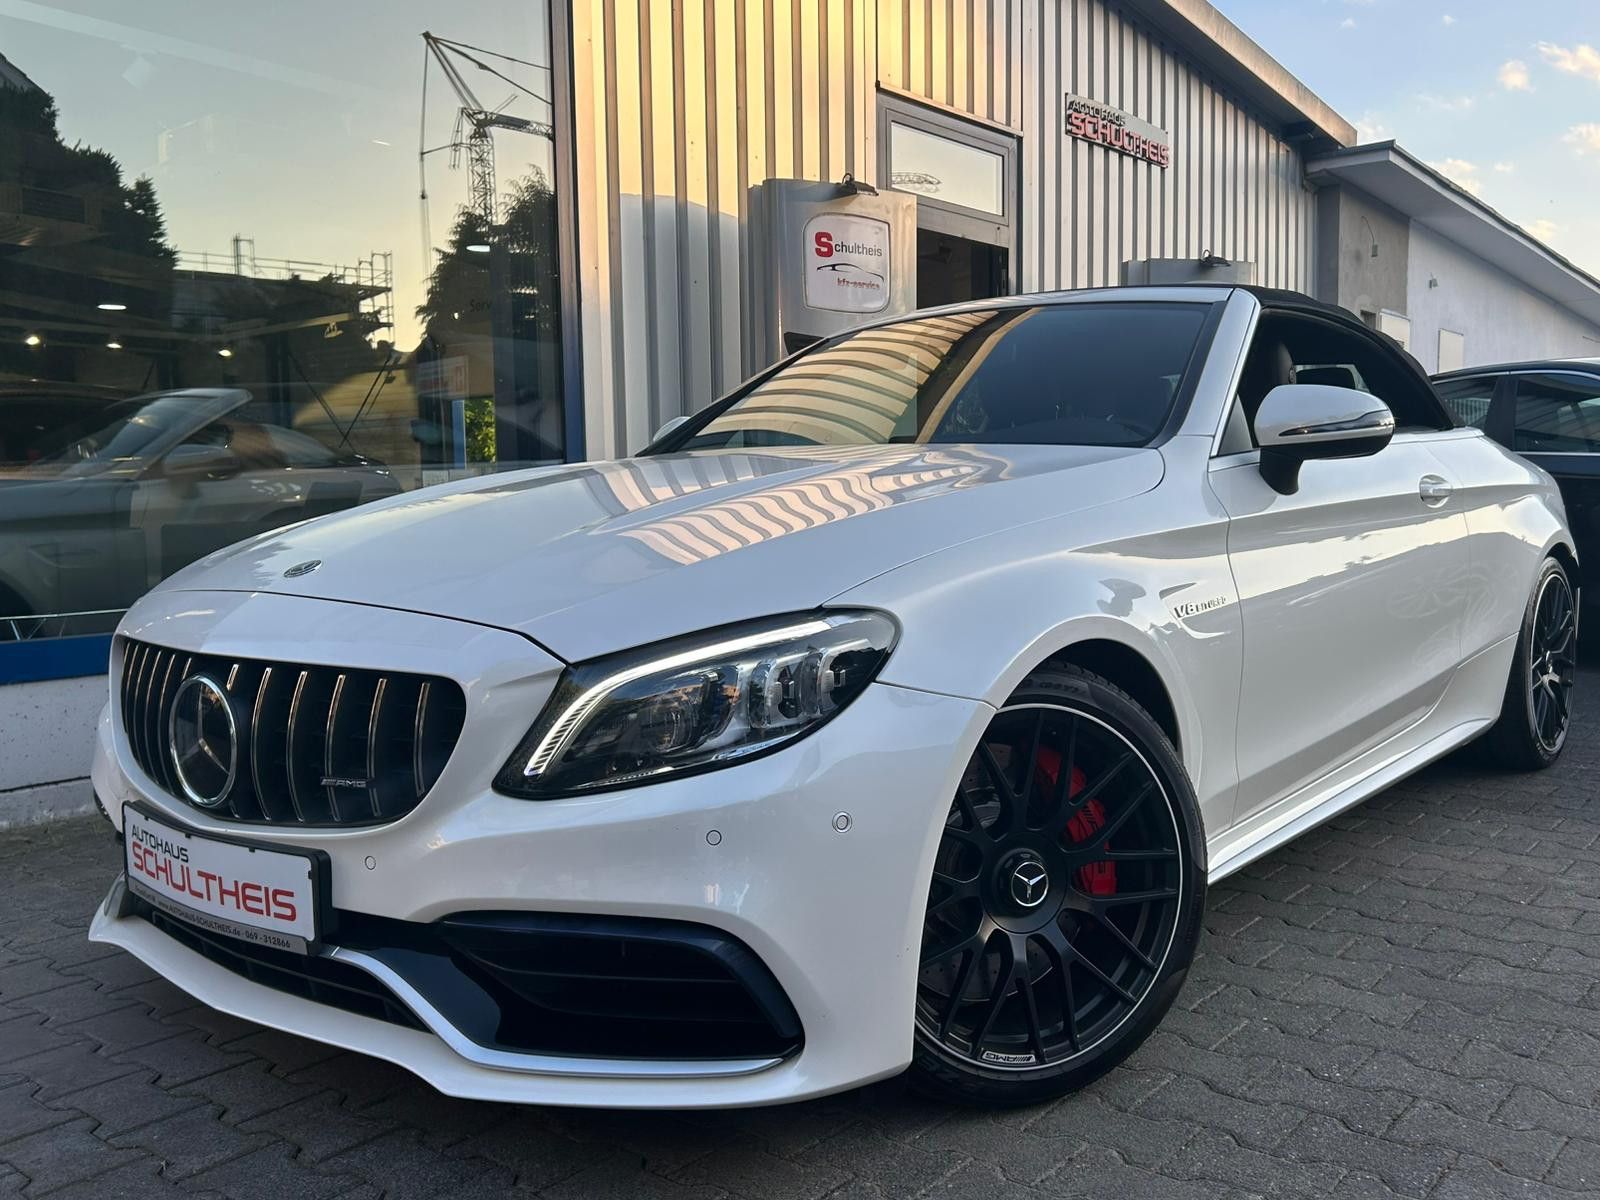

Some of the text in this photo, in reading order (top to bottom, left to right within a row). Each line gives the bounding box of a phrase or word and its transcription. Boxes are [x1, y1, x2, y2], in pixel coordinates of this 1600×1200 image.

[1068, 100, 1126, 126] AUTOHAUS
[1069, 111, 1169, 166] SCHULTHEIS
[814, 231, 883, 258] Schultheis
[1173, 602, 1195, 618] V8
[131, 824, 190, 863] AUTOHAUS
[132, 841, 297, 923] SCHULTHEIS
